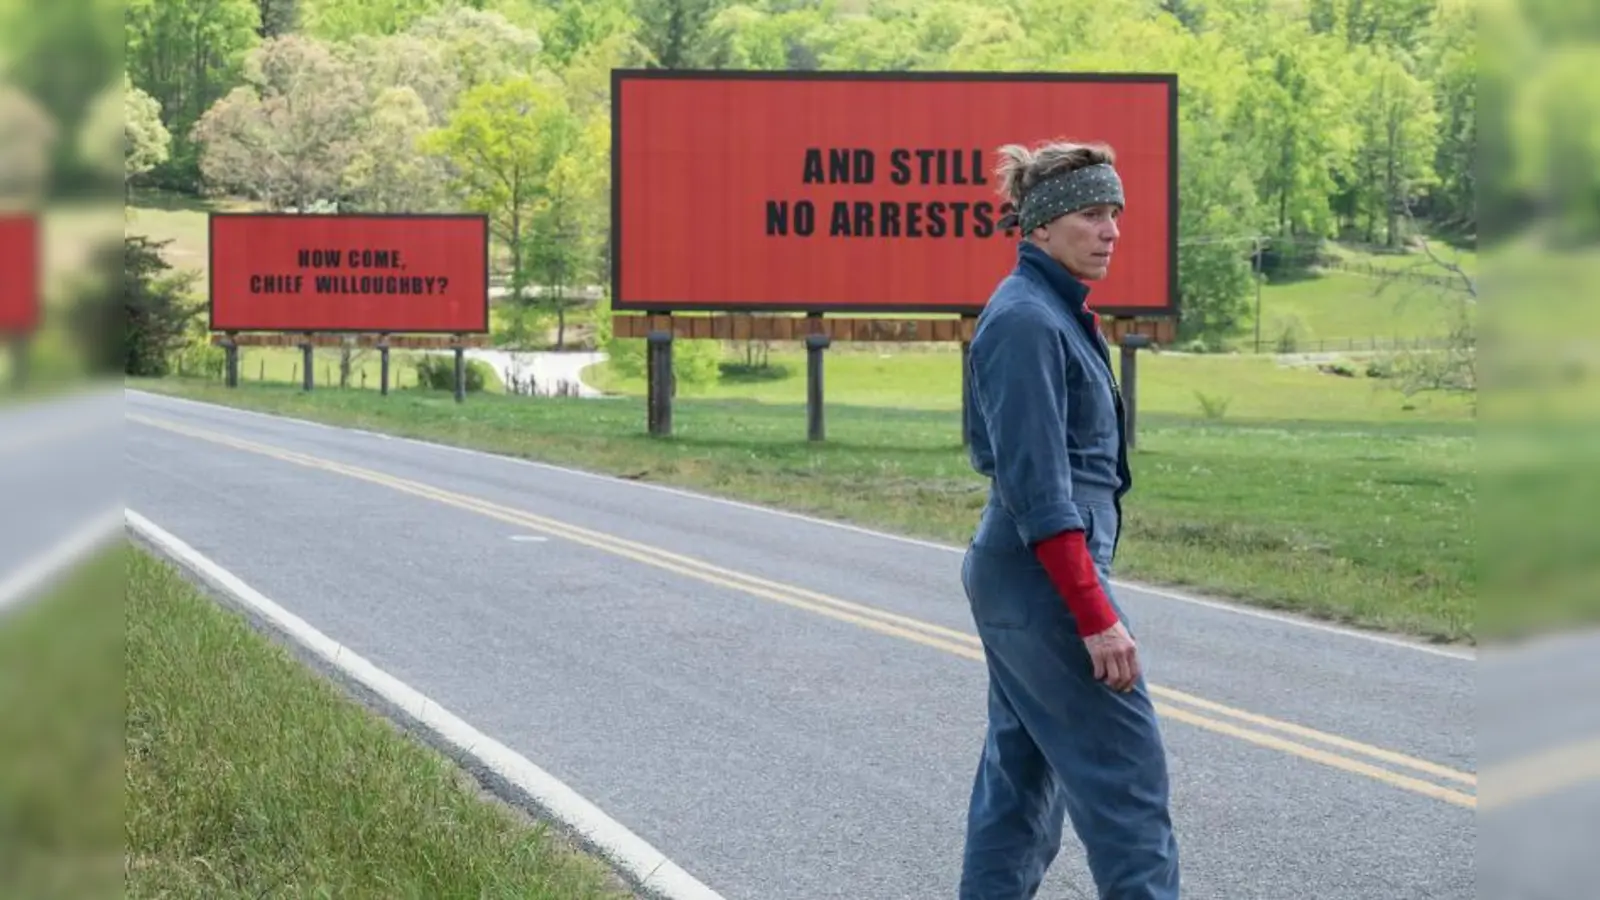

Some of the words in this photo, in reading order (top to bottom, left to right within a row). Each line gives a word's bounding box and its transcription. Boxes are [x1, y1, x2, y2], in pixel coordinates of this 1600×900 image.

[803, 148, 875, 184] AND
[890, 149, 988, 185] STILL
[766, 200, 815, 236] NO
[297, 249, 341, 268] HOW
[348, 250, 407, 270] COME,
[249, 275, 304, 293] CHIEF
[315, 276, 449, 295] WILLOUGHBY?
